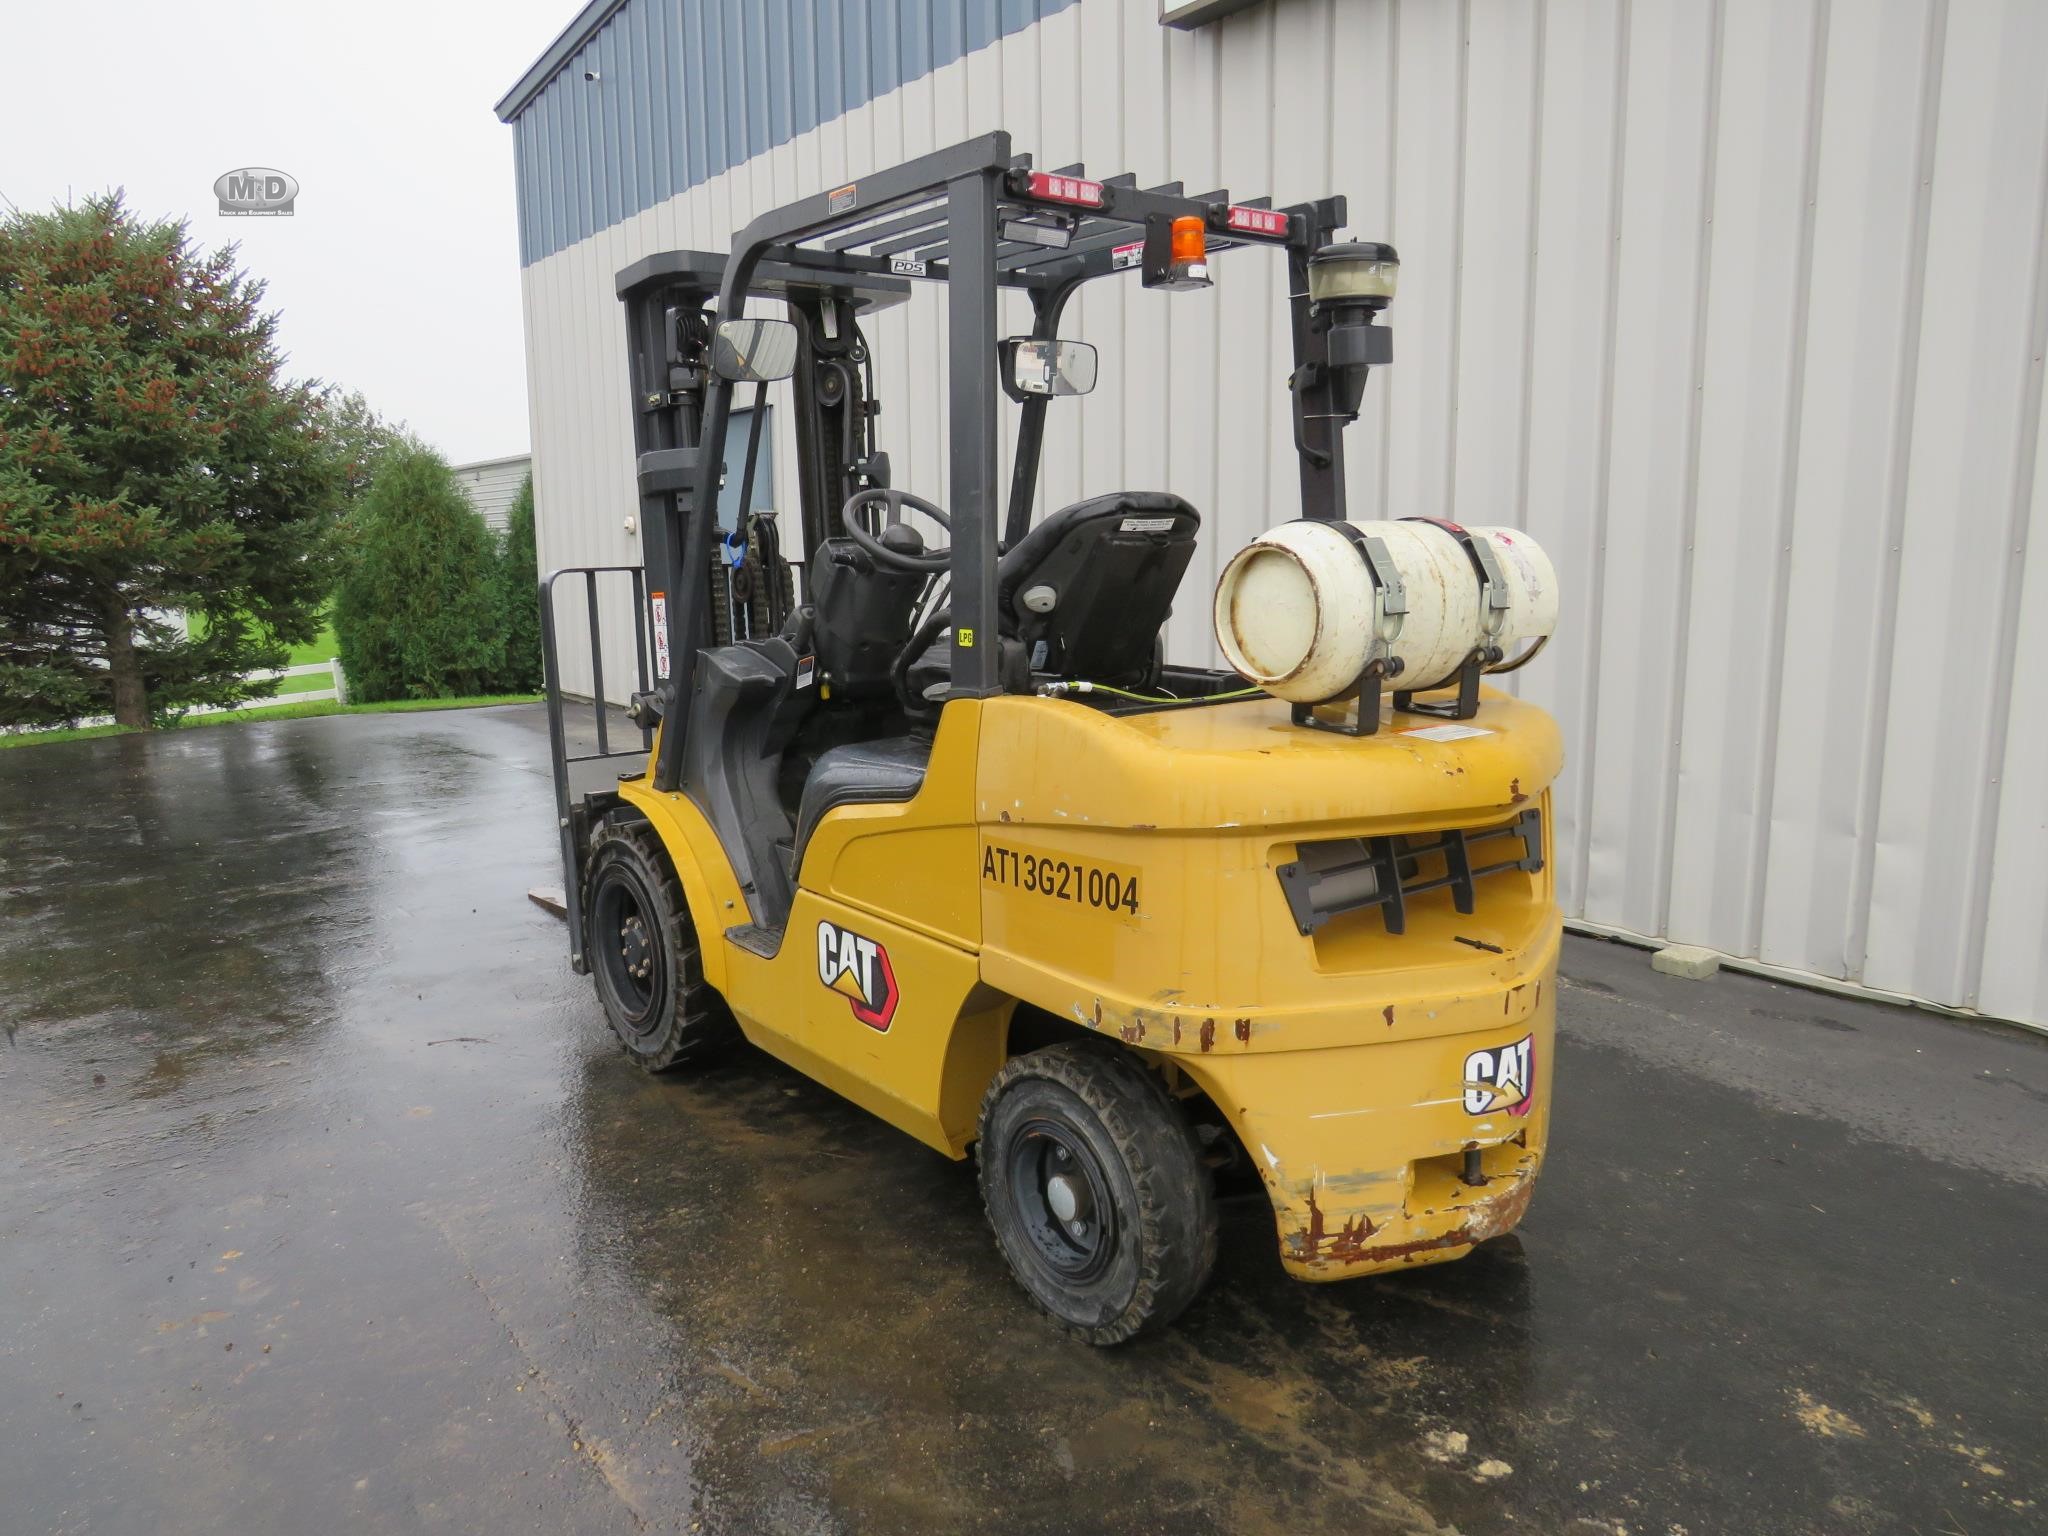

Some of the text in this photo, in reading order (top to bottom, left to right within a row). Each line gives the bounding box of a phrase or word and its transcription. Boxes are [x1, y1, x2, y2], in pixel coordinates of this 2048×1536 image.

[895, 261, 923, 272] PDS
[959, 632, 972, 643] LPG
[983, 845, 1139, 915] AT13G21004
[818, 921, 877, 1006] CAT
[1465, 1037, 1530, 1113] CAT
